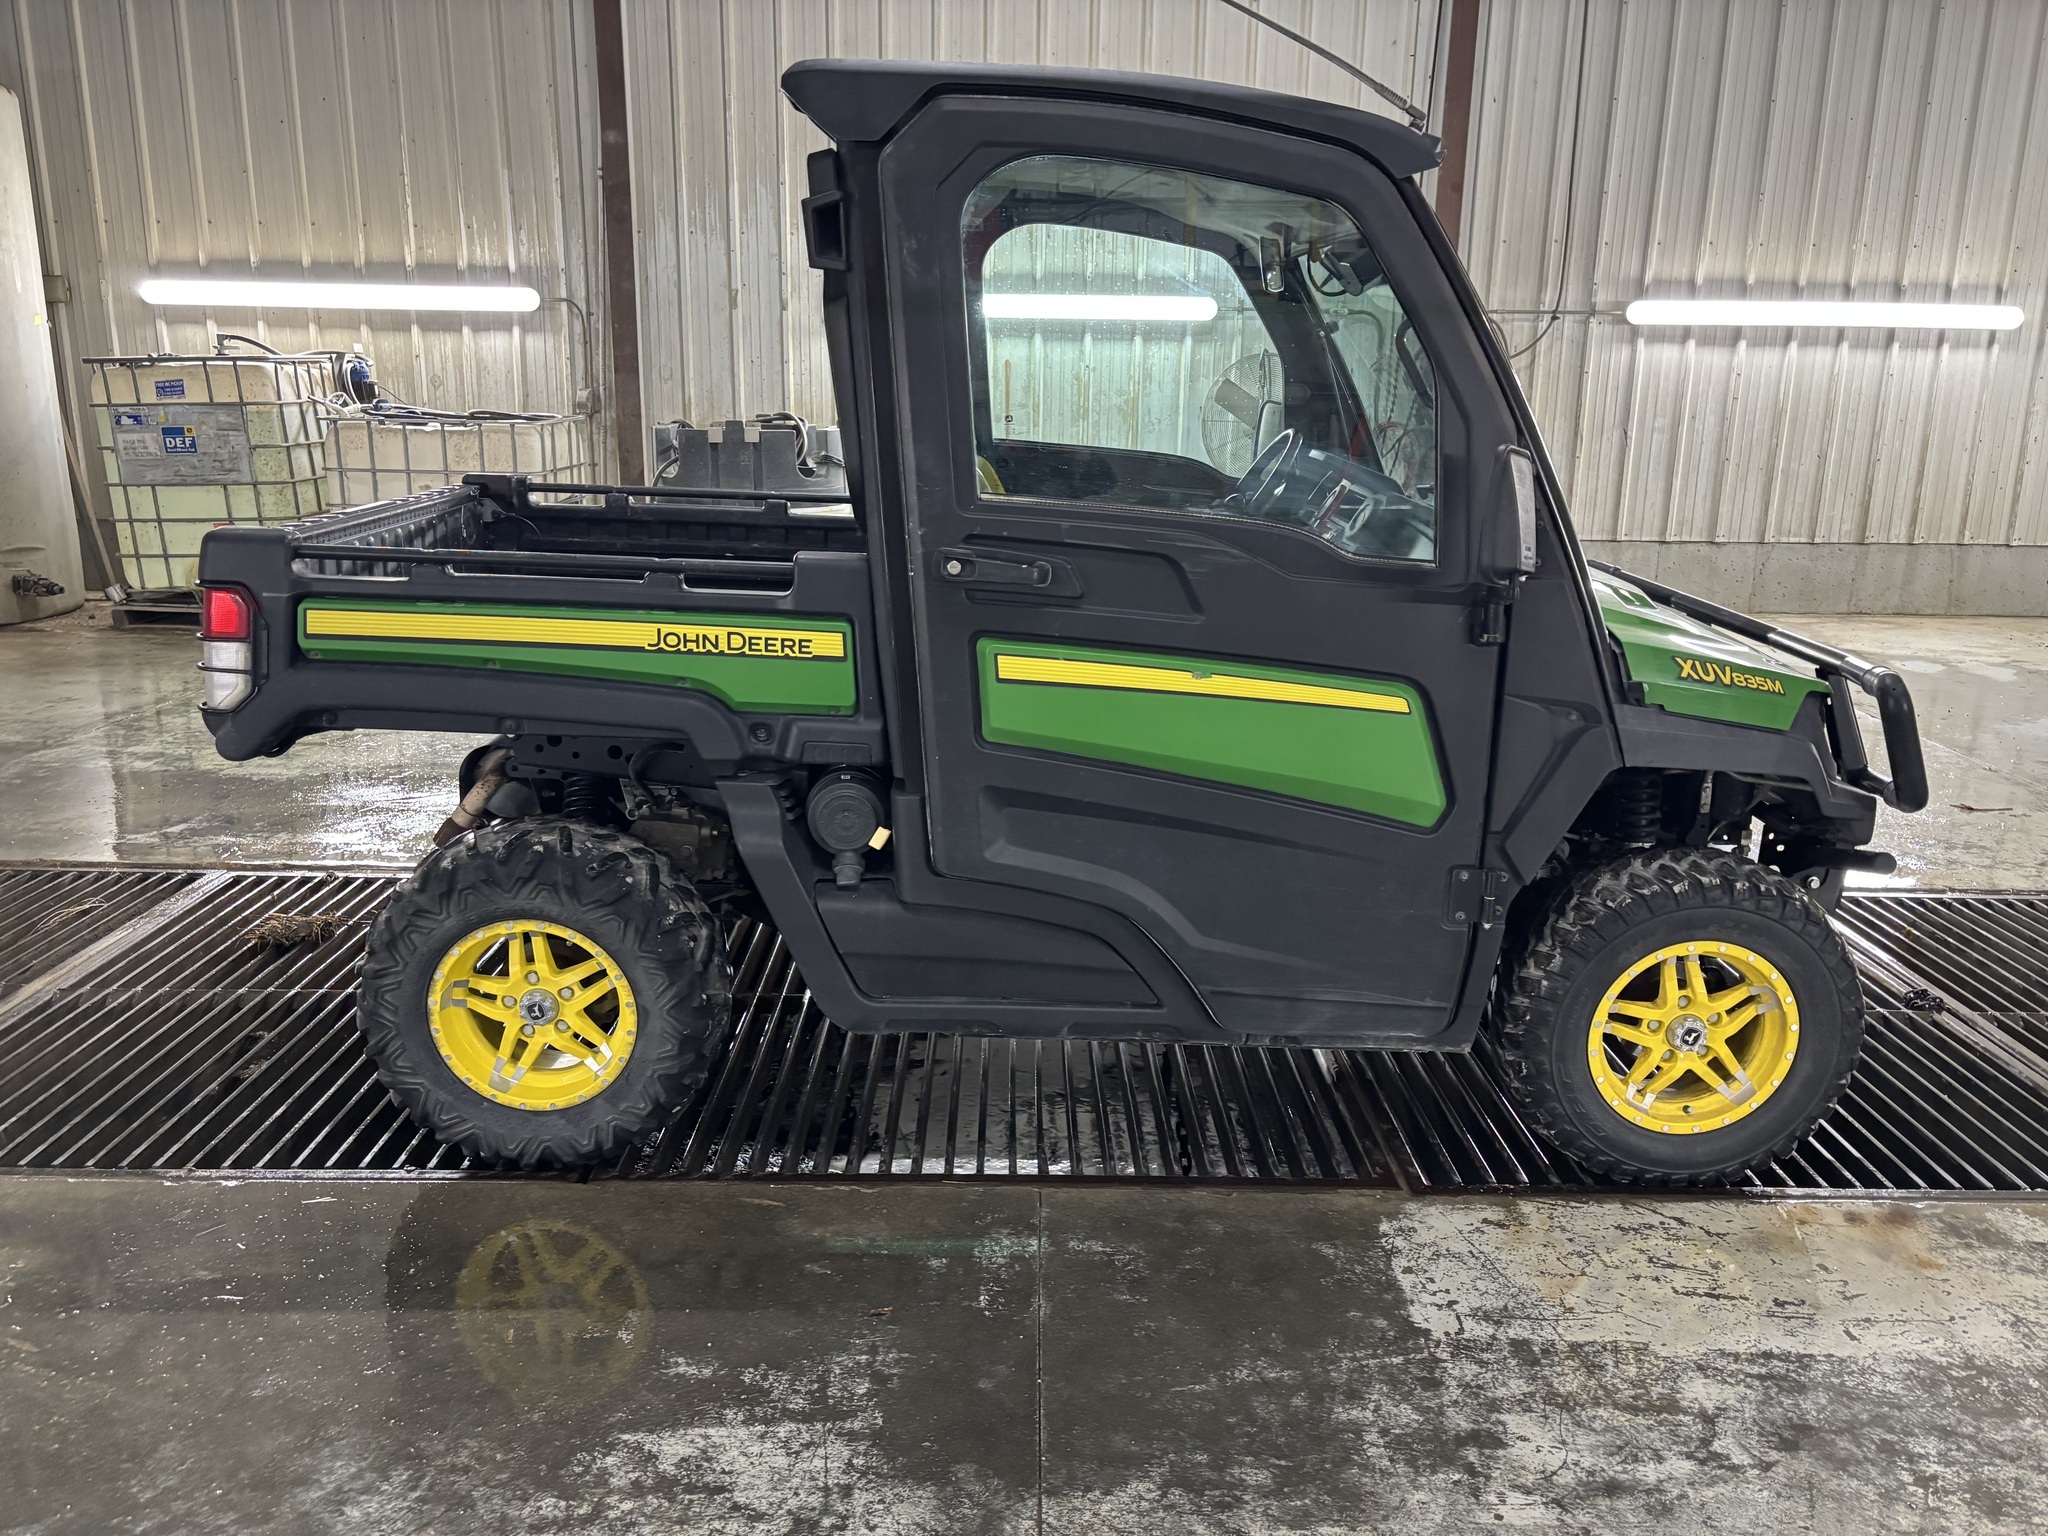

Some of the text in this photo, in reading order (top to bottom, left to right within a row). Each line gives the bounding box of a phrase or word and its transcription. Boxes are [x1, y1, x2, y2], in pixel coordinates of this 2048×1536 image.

[165, 437, 192, 448] DEF
[647, 628, 814, 655] JOHN DEERE
[1673, 656, 1785, 695] XUV835M
